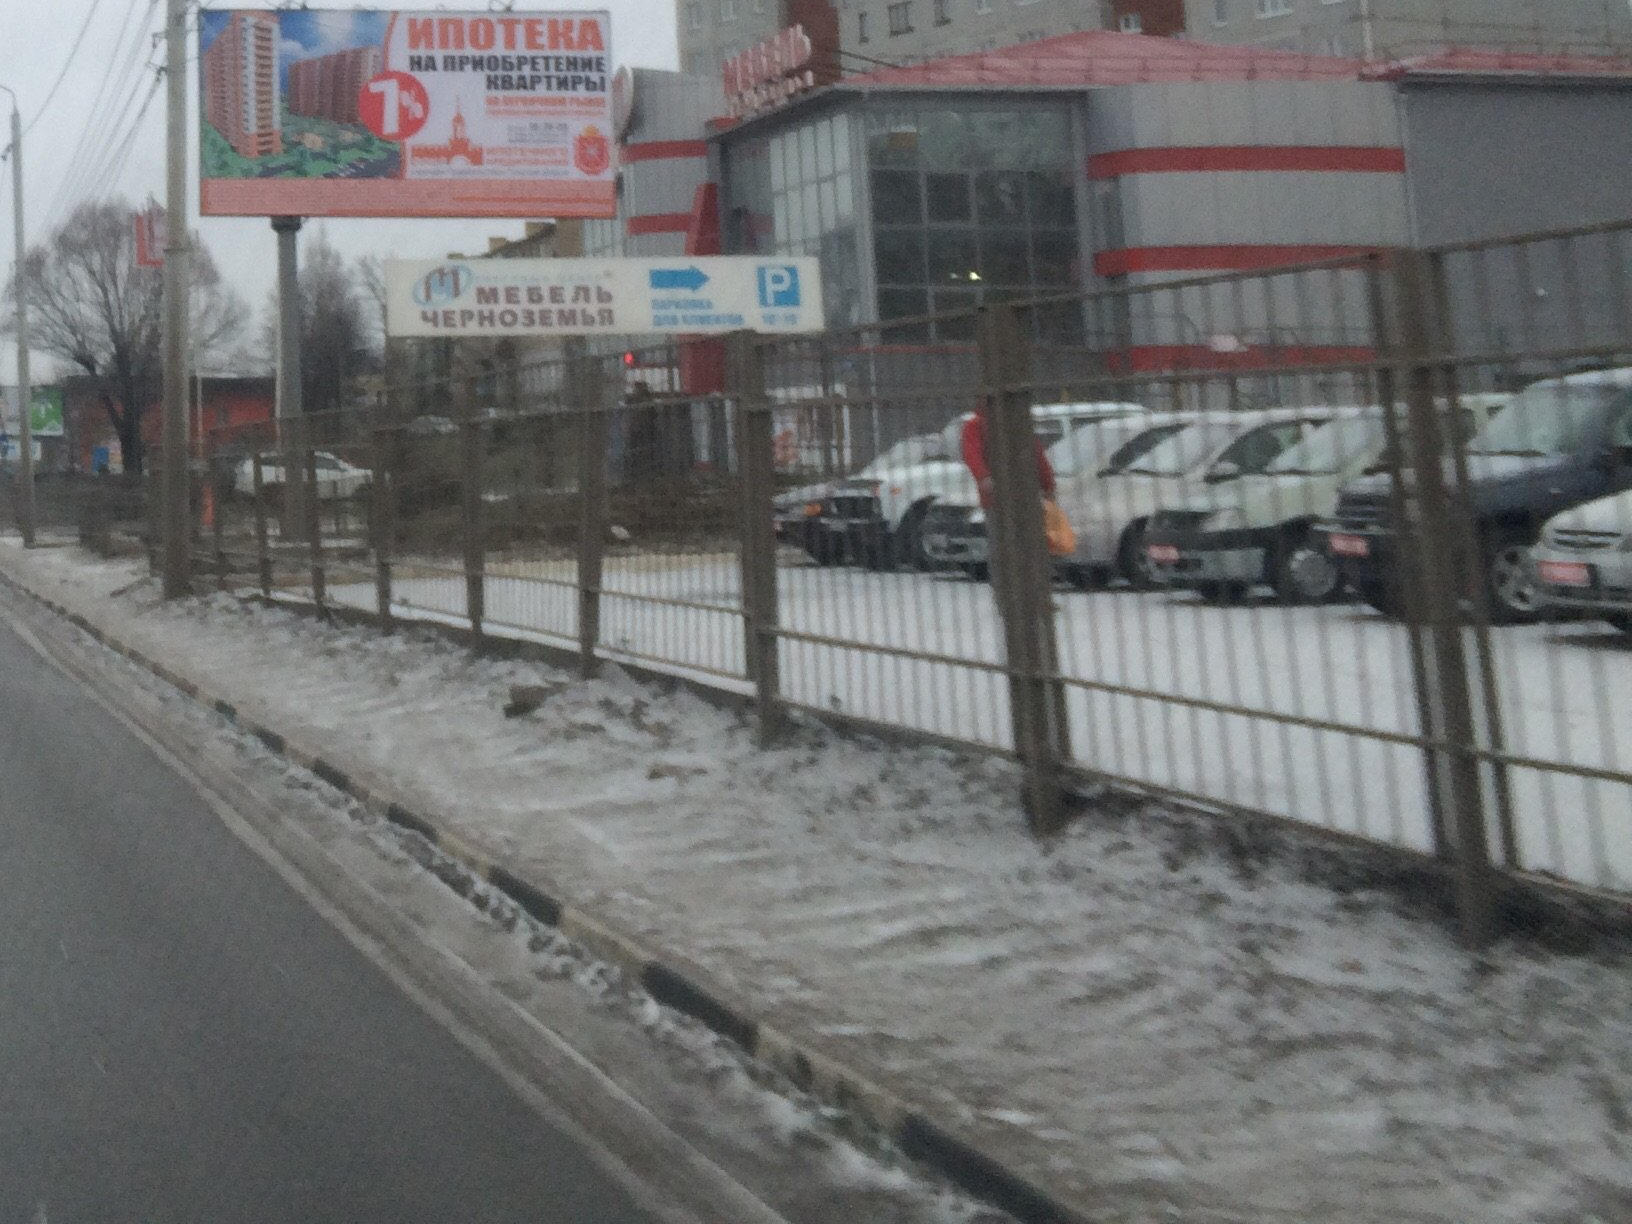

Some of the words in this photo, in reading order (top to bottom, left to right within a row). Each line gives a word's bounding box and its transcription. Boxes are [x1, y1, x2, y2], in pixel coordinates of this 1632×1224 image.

[407, 18, 605, 51] ИПОТЕКА
[409, 55, 437, 73] НА
[443, 55, 606, 73] ПРИОБРЕТЕНИЕ
[486, 75, 606, 93] КВАРТИРЫ
[476, 285, 613, 305] МЕБЕЛЬ
[421, 308, 615, 328] ЧЕРНОЗЕМЬЯ
